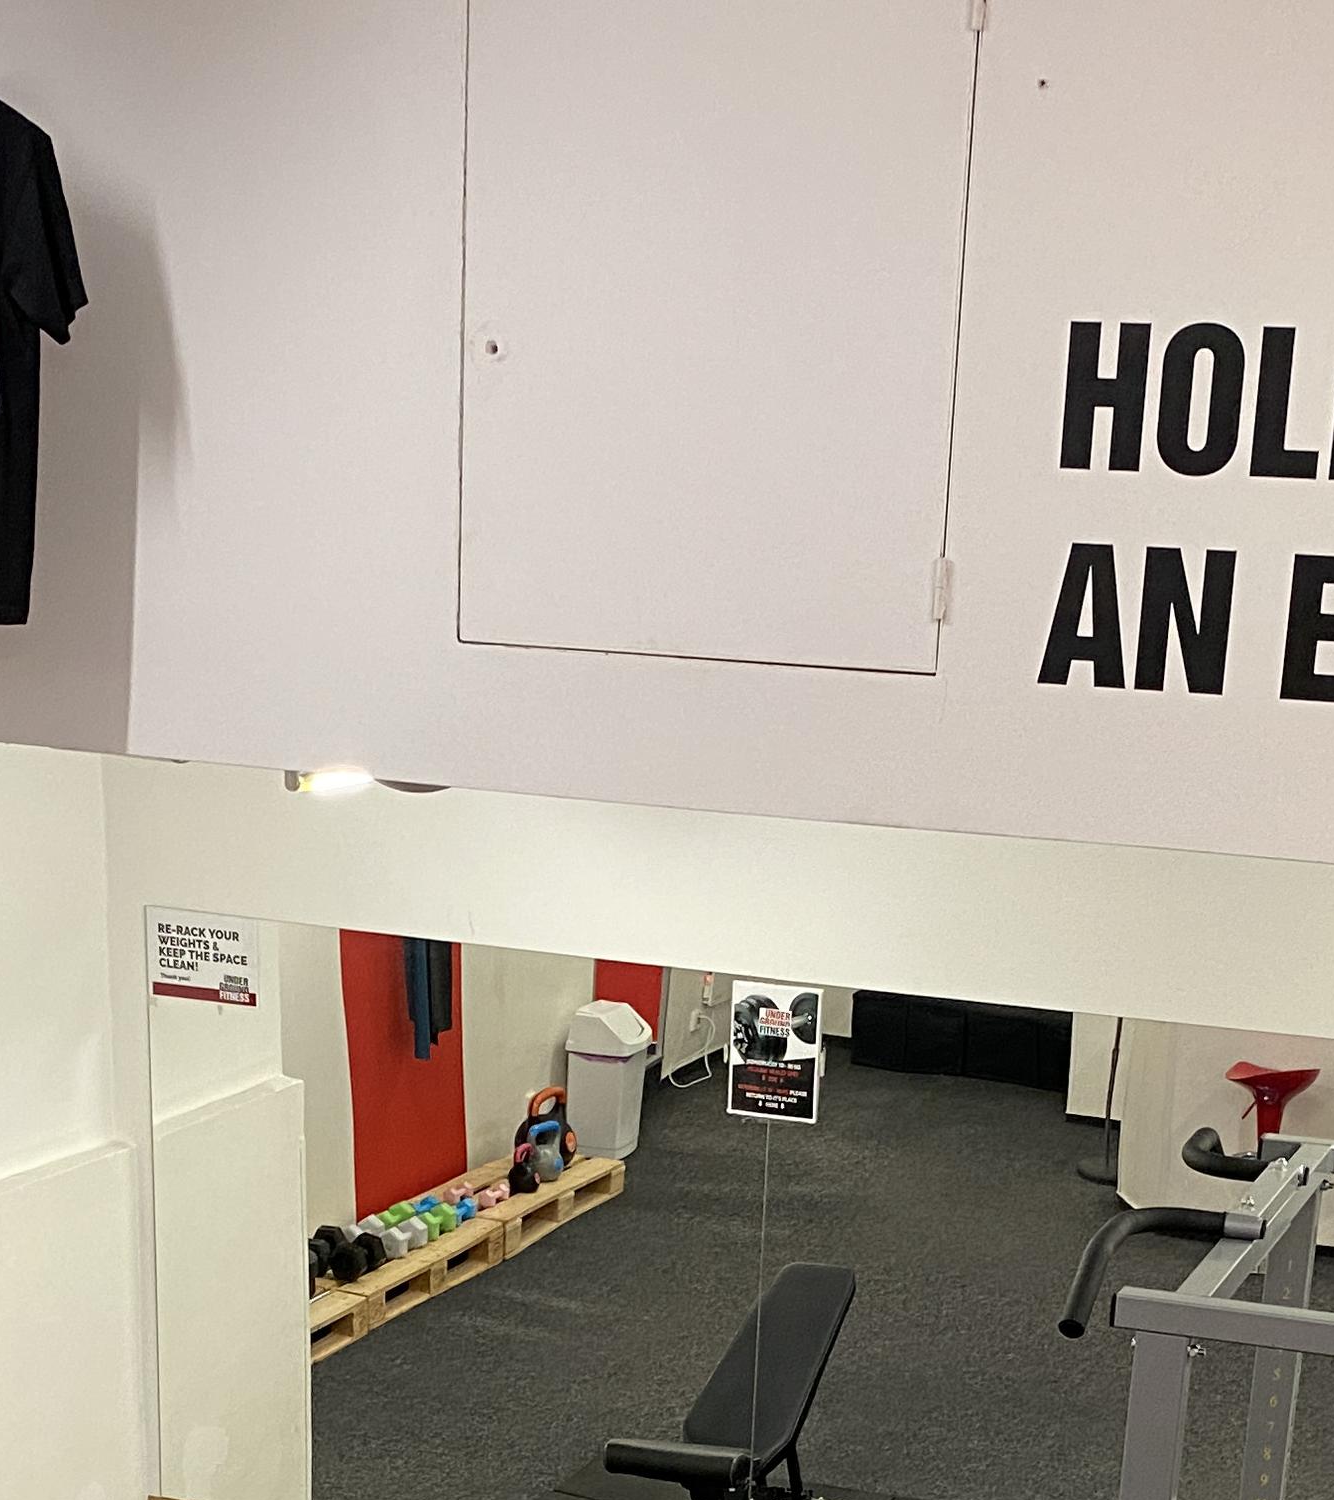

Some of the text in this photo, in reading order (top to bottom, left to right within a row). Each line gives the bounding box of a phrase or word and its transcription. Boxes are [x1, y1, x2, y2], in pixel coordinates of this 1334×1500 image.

[1037, 542, 1237, 696] AN
[158, 922, 240, 942] RE-RACK YOUR
[158, 935, 220, 951] WEIGHTS &
[159, 946, 248, 966] KEEP THE SPACE
[159, 958, 199, 972] CLEAN!
[759, 1026, 791, 1037] FITNESS
